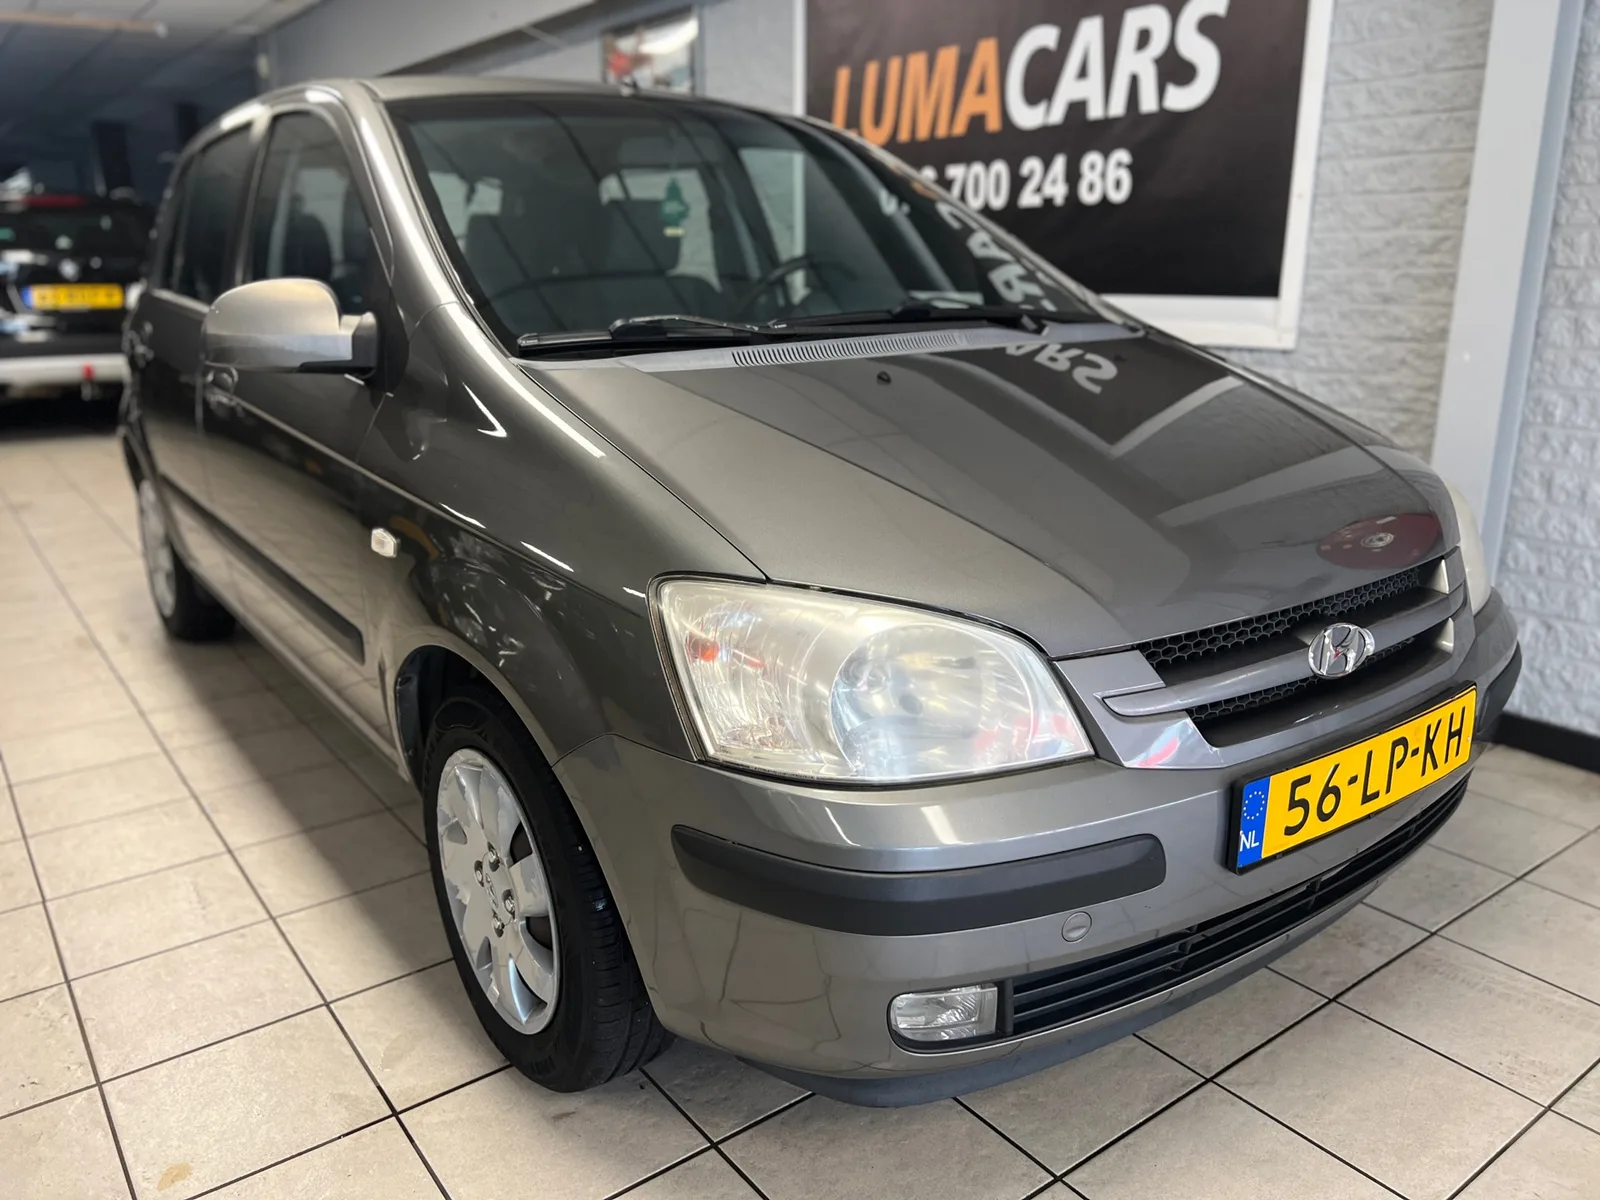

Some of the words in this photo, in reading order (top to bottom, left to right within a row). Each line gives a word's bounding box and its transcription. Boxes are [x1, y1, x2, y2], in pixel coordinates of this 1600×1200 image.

[944, 159, 1010, 211] 700
[1017, 153, 1069, 208] 24
[1076, 148, 1133, 206] 86
[1283, 706, 1466, 837] 56-LP-KH
[1239, 830, 1260, 852] NL
